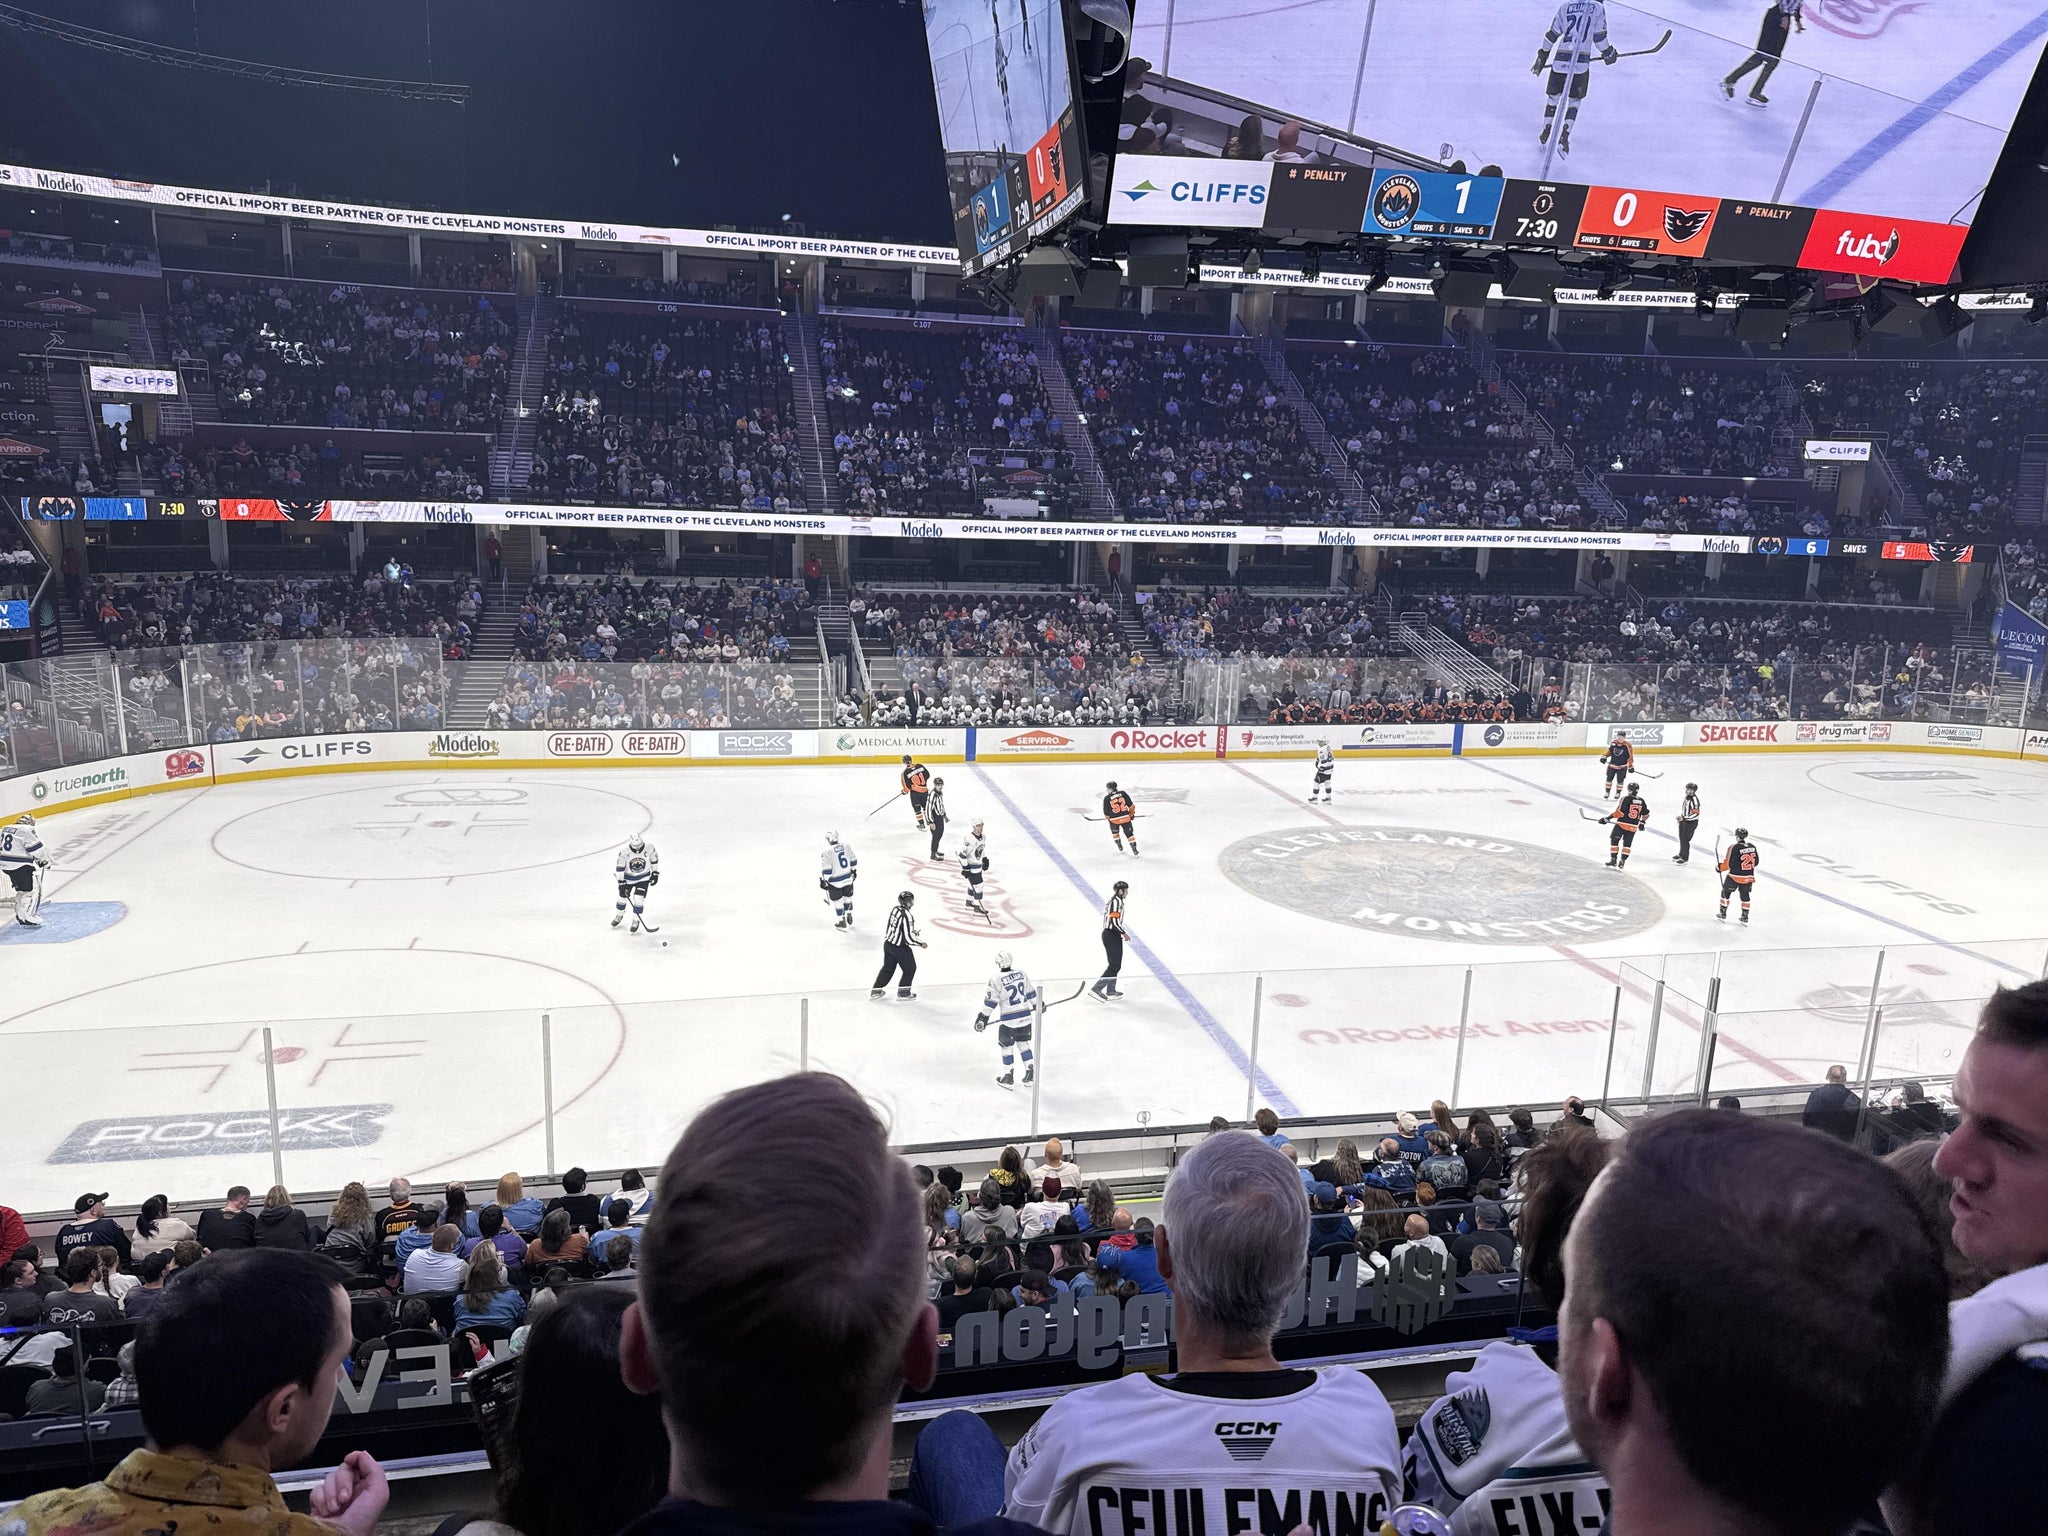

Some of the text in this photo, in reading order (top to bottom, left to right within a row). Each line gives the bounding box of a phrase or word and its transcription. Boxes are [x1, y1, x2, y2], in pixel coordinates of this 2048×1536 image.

[1035, 146, 1045, 185] 0
[37, 173, 84, 193] Modelo
[1289, 169, 1348, 182] # PENALTY
[1171, 182, 1266, 205] CLIFFS
[1382, 177, 1418, 195] CLEVELAND
[992, 184, 999, 218] 1
[1455, 179, 1473, 215] 1
[176, 191, 565, 234] OFFICIAL IMPORT BEER PARTNER OF THE CLEVELAND MONSTERS
[1015, 200, 1029, 229] 7:30
[1612, 192, 1638, 228] 0
[1735, 205, 1793, 221] # PENALTY
[1377, 213, 1410, 228] MONSTERS
[1412, 223, 1445, 233] SHOTS 6
[581, 226, 617, 241] Modelo
[1453, 226, 1485, 236] SAVES 6
[1516, 218, 1559, 239] 7:30
[706, 235, 756, 247] OFFICIAL
[757, 238, 798, 250] IMPORT
[800, 241, 828, 252] BEER
[830, 244, 878, 256] PARTNER
[880, 247, 894, 257] OF
[896, 248, 917, 259] THE
[1580, 234, 1615, 246] SHOTS 6
[1621, 237, 1641, 248] SAVES
[1647, 239, 1655, 249] 5
[1201, 269, 1235, 280] IMPORT
[1237, 271, 1261, 281] BEER
[1263, 272, 1306, 283] PARTNER
[1322, 277, 1340, 286] THE
[1618, 294, 1643, 302] BEER
[1644, 295, 1688, 304] PARTNER
[123, 375, 174, 387] CLIFFS
[1829, 447, 1868, 455] CLIFFS
[124, 502, 133, 516] 1
[159, 501, 185, 516] 7:30
[424, 506, 473, 523] Modelo
[505, 510, 826, 530] OFFICIAL IMPORT BEER PARTNER OF THE CLEVELAND MONSTERS
[901, 521, 943, 537] Modelo
[962, 525, 1237, 540] OFFICIAL IMPORT BEER PARTNER OF THE CLEVELAND MONSTERS
[1318, 531, 1356, 546] Modelo
[1373, 534, 1410, 542] OFFICIAL
[1411, 535, 1442, 543] IMPORT
[1444, 535, 1465, 543] BEER
[1517, 536, 1532, 544] THE
[1533, 537, 1579, 545] CLEVELAND
[1581, 538, 1622, 546] MONSTERS
[1702, 539, 1740, 553] Modelo
[1806, 542, 1868, 554] 6 SAVES
[1895, 545, 1906, 557] 5
[2000, 630, 2046, 646] LECOM
[1699, 723, 1779, 743] SEATGEEK
[1798, 725, 1814, 734] drug
[1799, 730, 1816, 738] mart
[1819, 726, 1868, 738] drug mart
[1871, 725, 1889, 734] drug
[1872, 731, 1891, 739] mart
[1958, 730, 1980, 738] GENIUS
[436, 734, 490, 751] Modelo
[725, 736, 787, 748] ROCK
[857, 737, 946, 747] MEDICAL MUTUAL
[1016, 737, 1060, 745] SERVPRO
[1132, 730, 1207, 749] Rocket
[281, 740, 372, 760] CLIFFS
[54, 766, 126, 793] truenorth
[1109, 797, 1129, 814] 52
[1251, 829, 1515, 859] CLEVELAND
[837, 852, 848, 869] 6
[1791, 853, 1980, 916] CLIFFS
[1349, 898, 1634, 939] MONSTERS
[1336, 1018, 1637, 1045] Rocket Arena
[88, 1111, 365, 1147] ROCK
[62, 1231, 93, 1246] BOWEY
[1214, 1422, 1277, 1435] CCM
